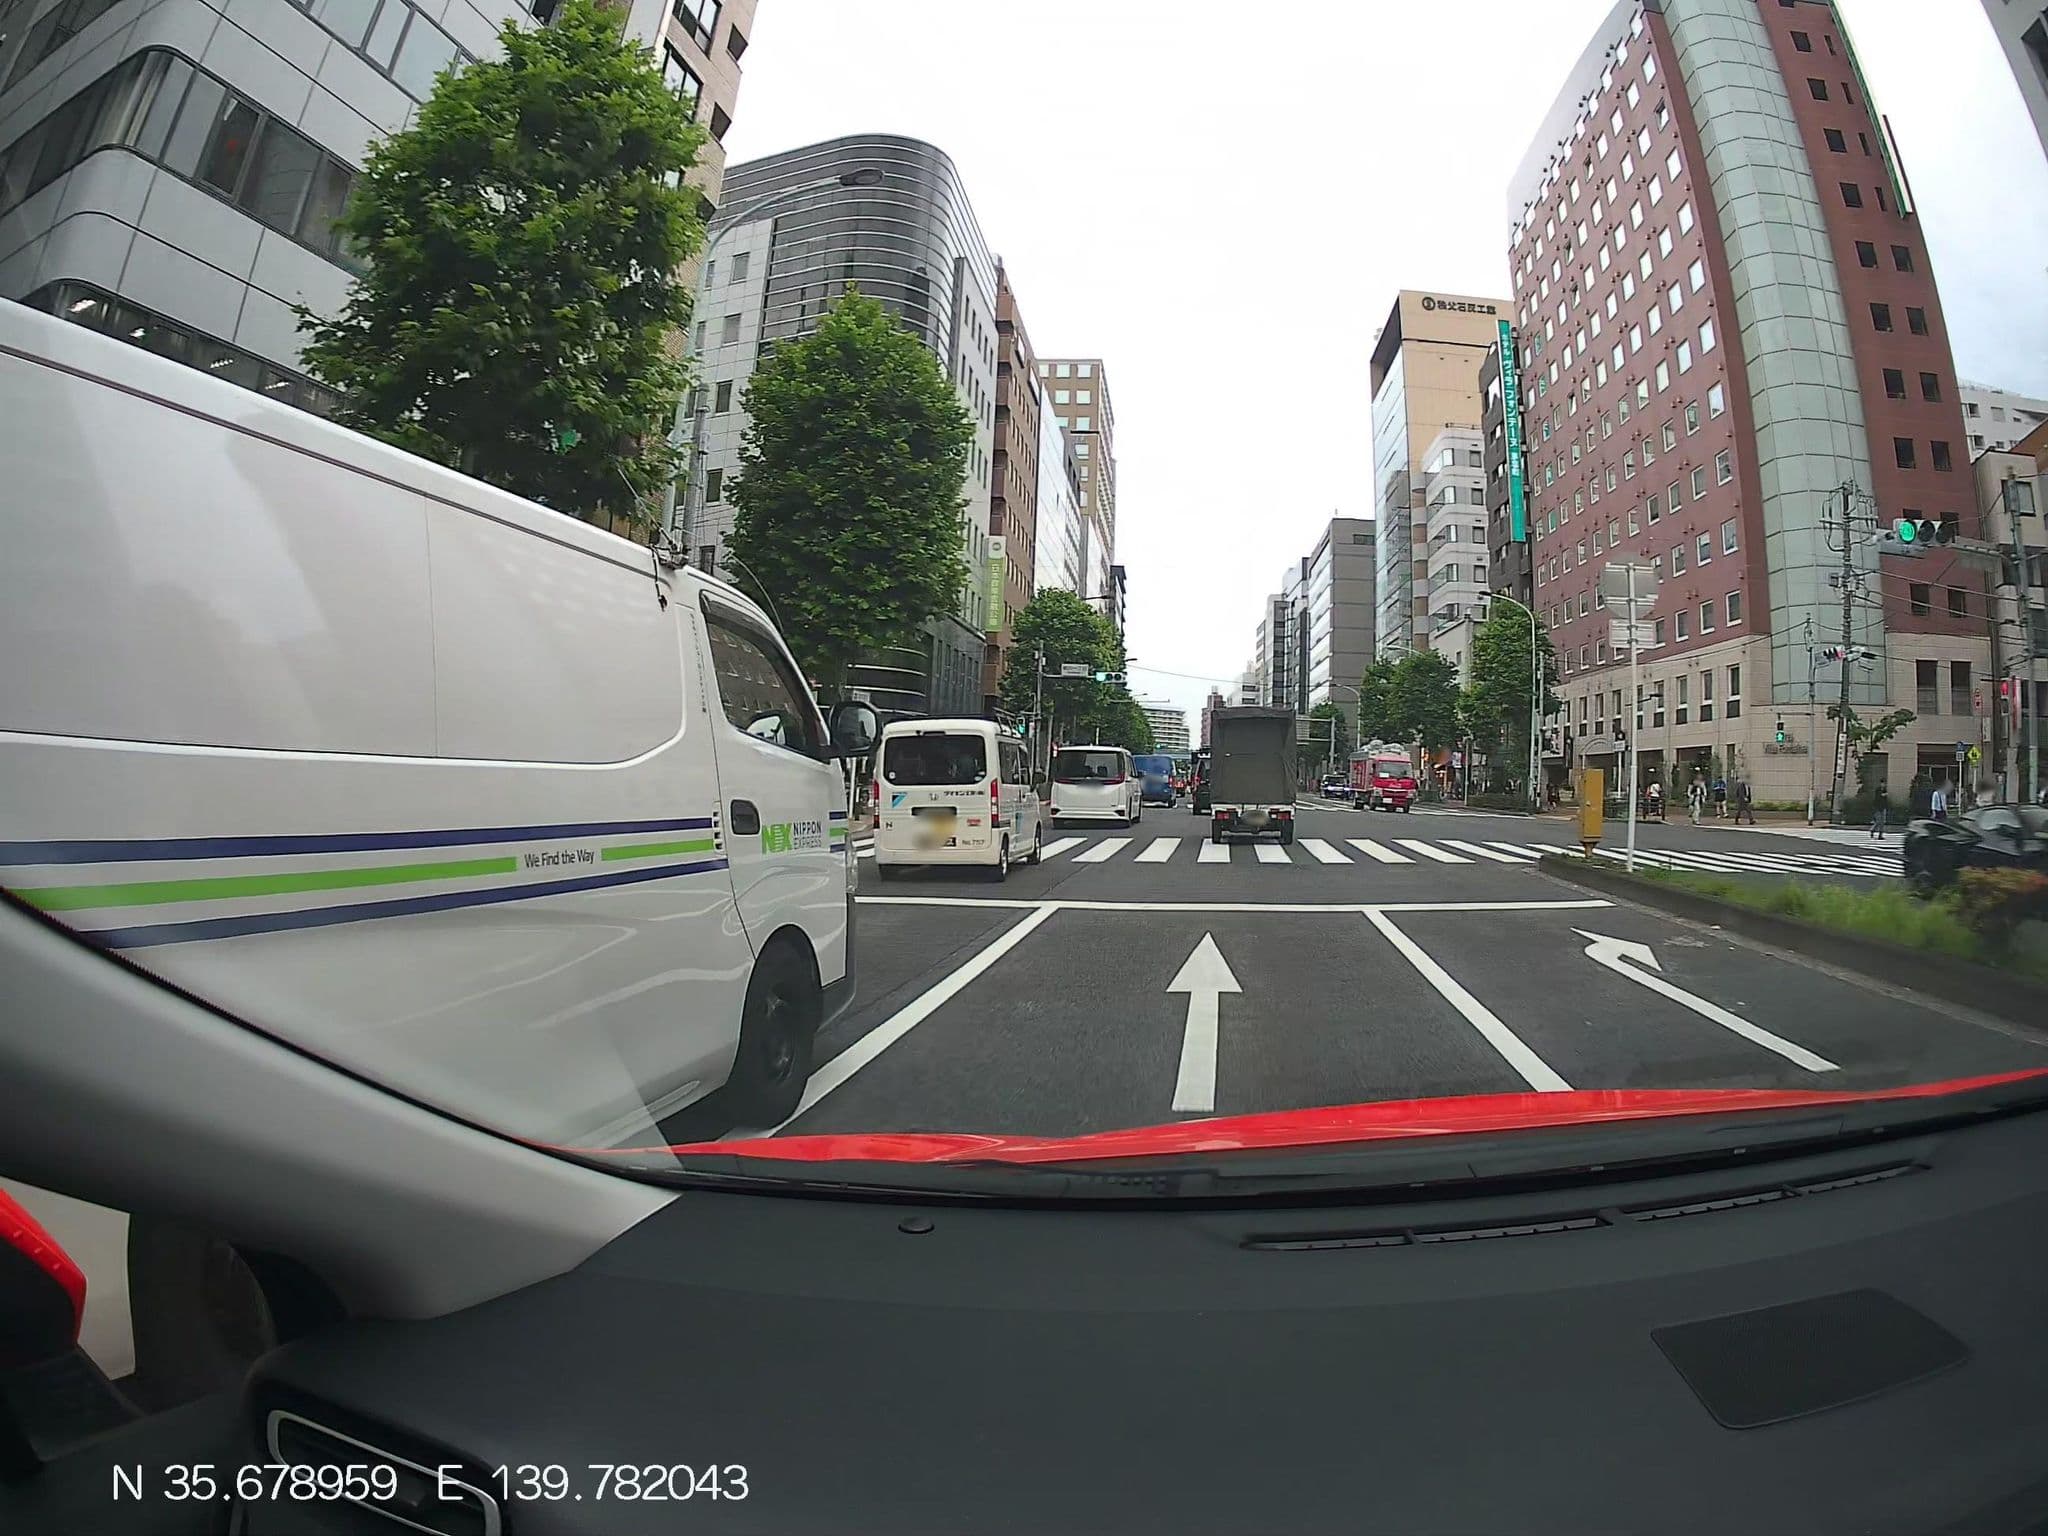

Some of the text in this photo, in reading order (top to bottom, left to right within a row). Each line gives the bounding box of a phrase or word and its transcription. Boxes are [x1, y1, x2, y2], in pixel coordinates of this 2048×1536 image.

[793, 820, 822, 836] NIPPON
[793, 835, 822, 850] EXPRESS
[524, 848, 595, 868] We Find the Way
